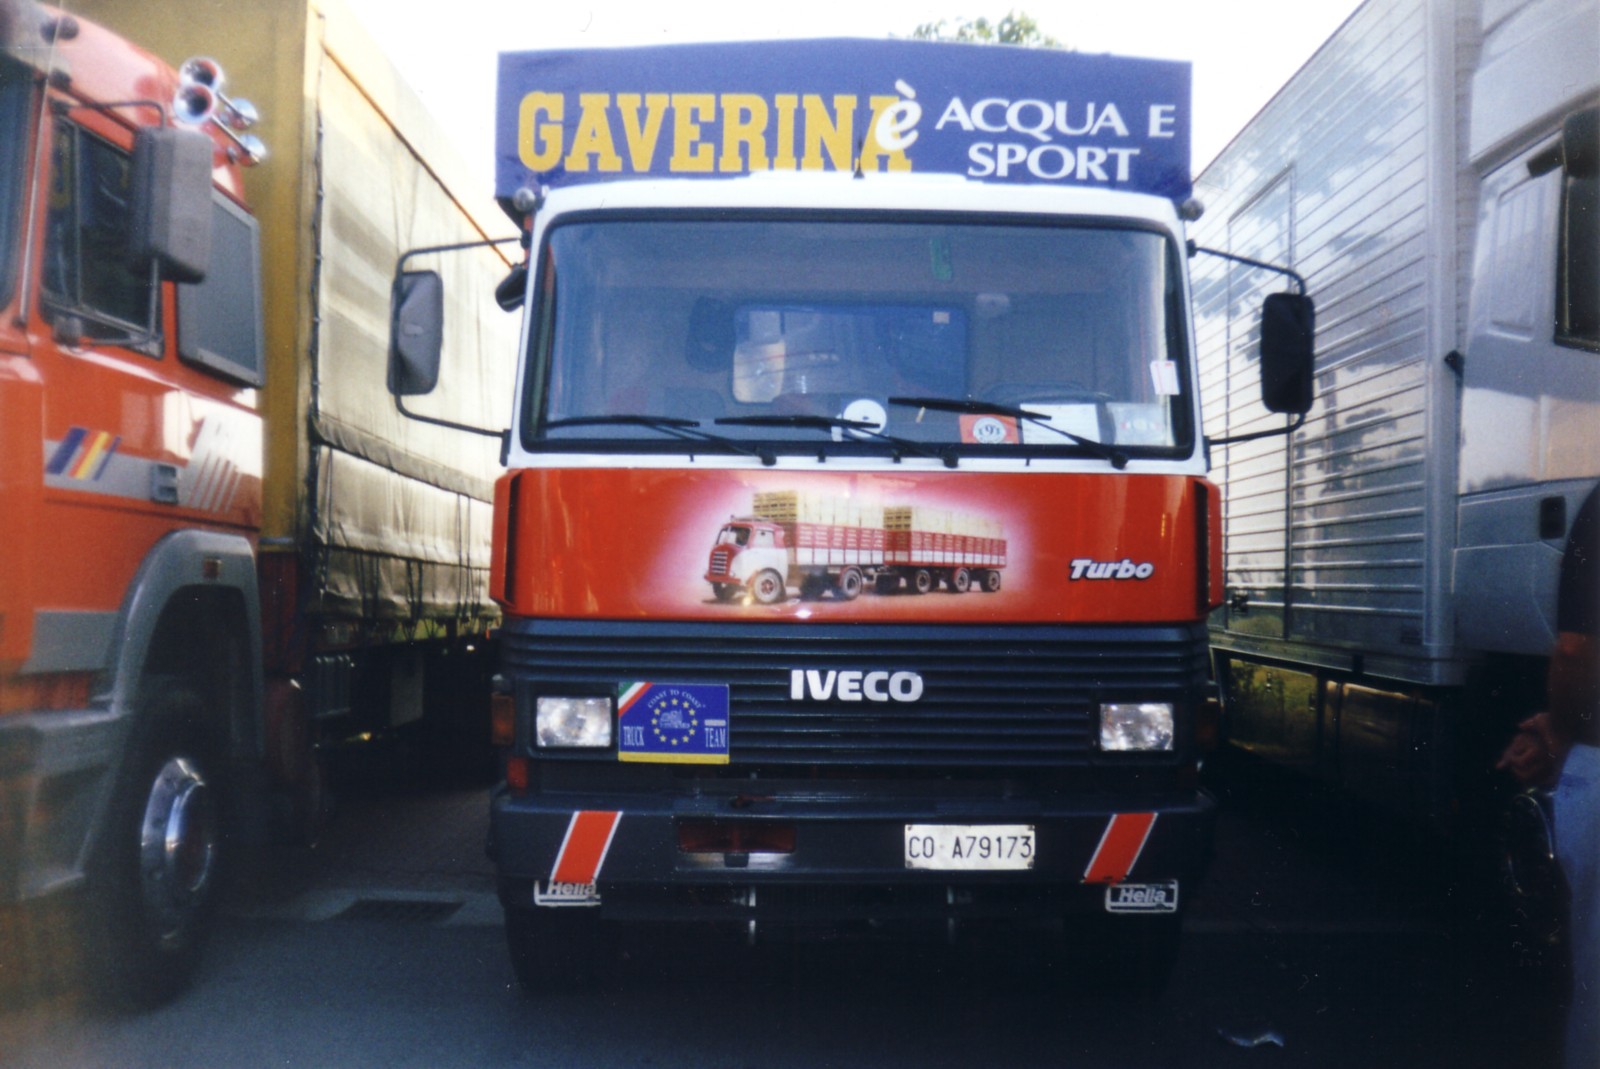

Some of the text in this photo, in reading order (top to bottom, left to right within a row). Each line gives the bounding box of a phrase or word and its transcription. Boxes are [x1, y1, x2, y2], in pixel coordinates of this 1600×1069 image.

[935, 97, 1176, 143] ACQUA E
[517, 90, 913, 173] GAVERINA
[967, 142, 1141, 182] SPORT
[1069, 558, 1155, 580] Turbo
[790, 669, 924, 702] IVECO
[647, 690, 668, 709] COAST
[669, 688, 681, 697] TO
[623, 725, 645, 747] TRUCK
[704, 727, 726, 748] TEAM
[909, 836, 1032, 859] CO A79173
[546, 881, 597, 897] Hella
[1118, 886, 1167, 904] Hella
